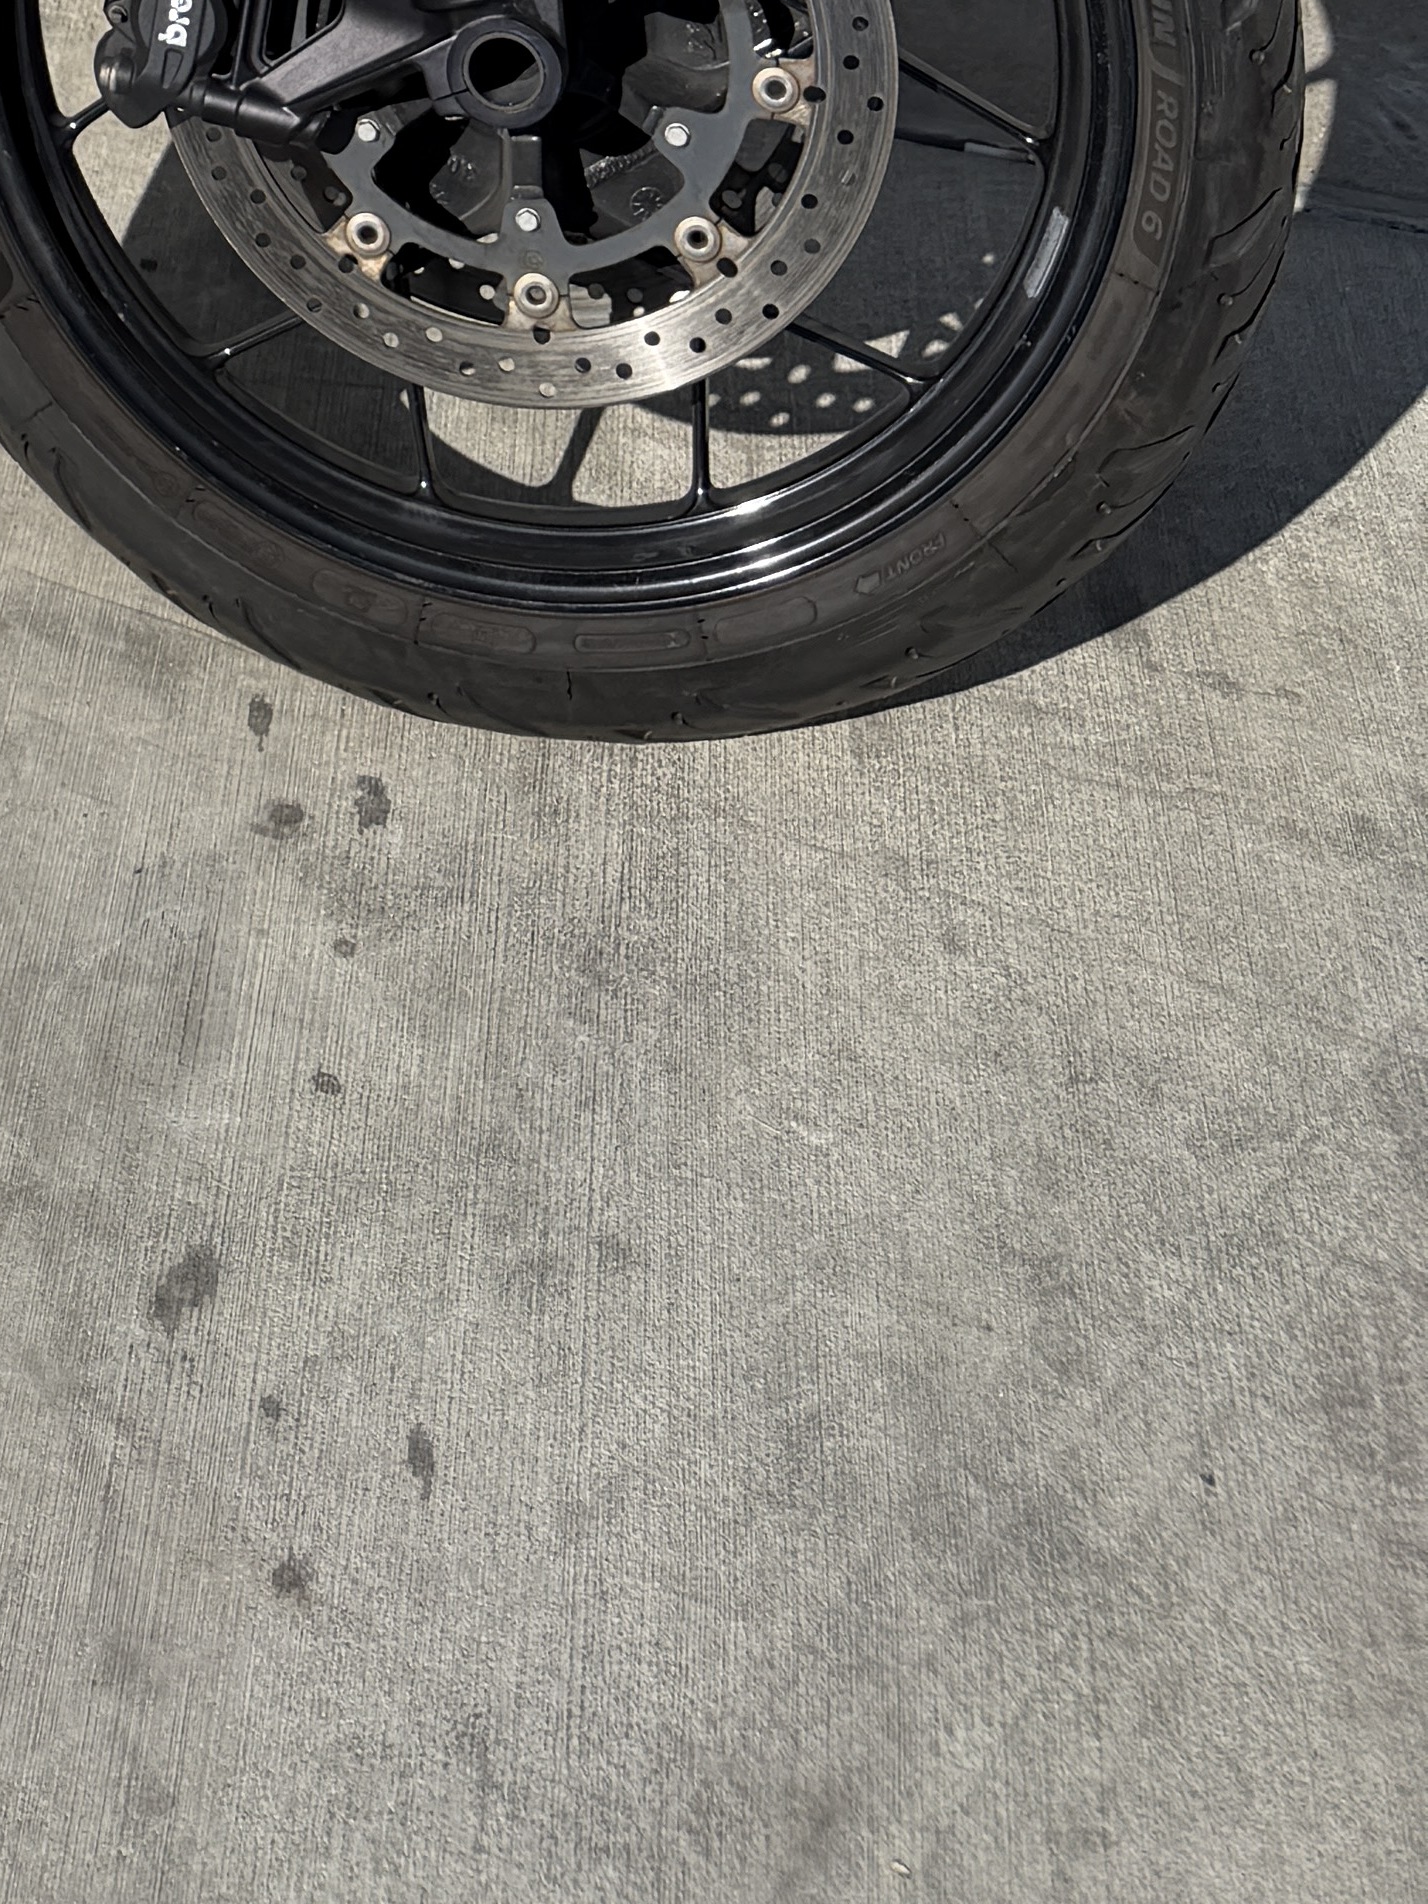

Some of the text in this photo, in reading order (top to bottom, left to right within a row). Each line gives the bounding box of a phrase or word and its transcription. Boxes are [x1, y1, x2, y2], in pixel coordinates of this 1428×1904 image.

[1140, 88, 1178, 241] ROAD 6
[885, 532, 948, 580] FRONT
